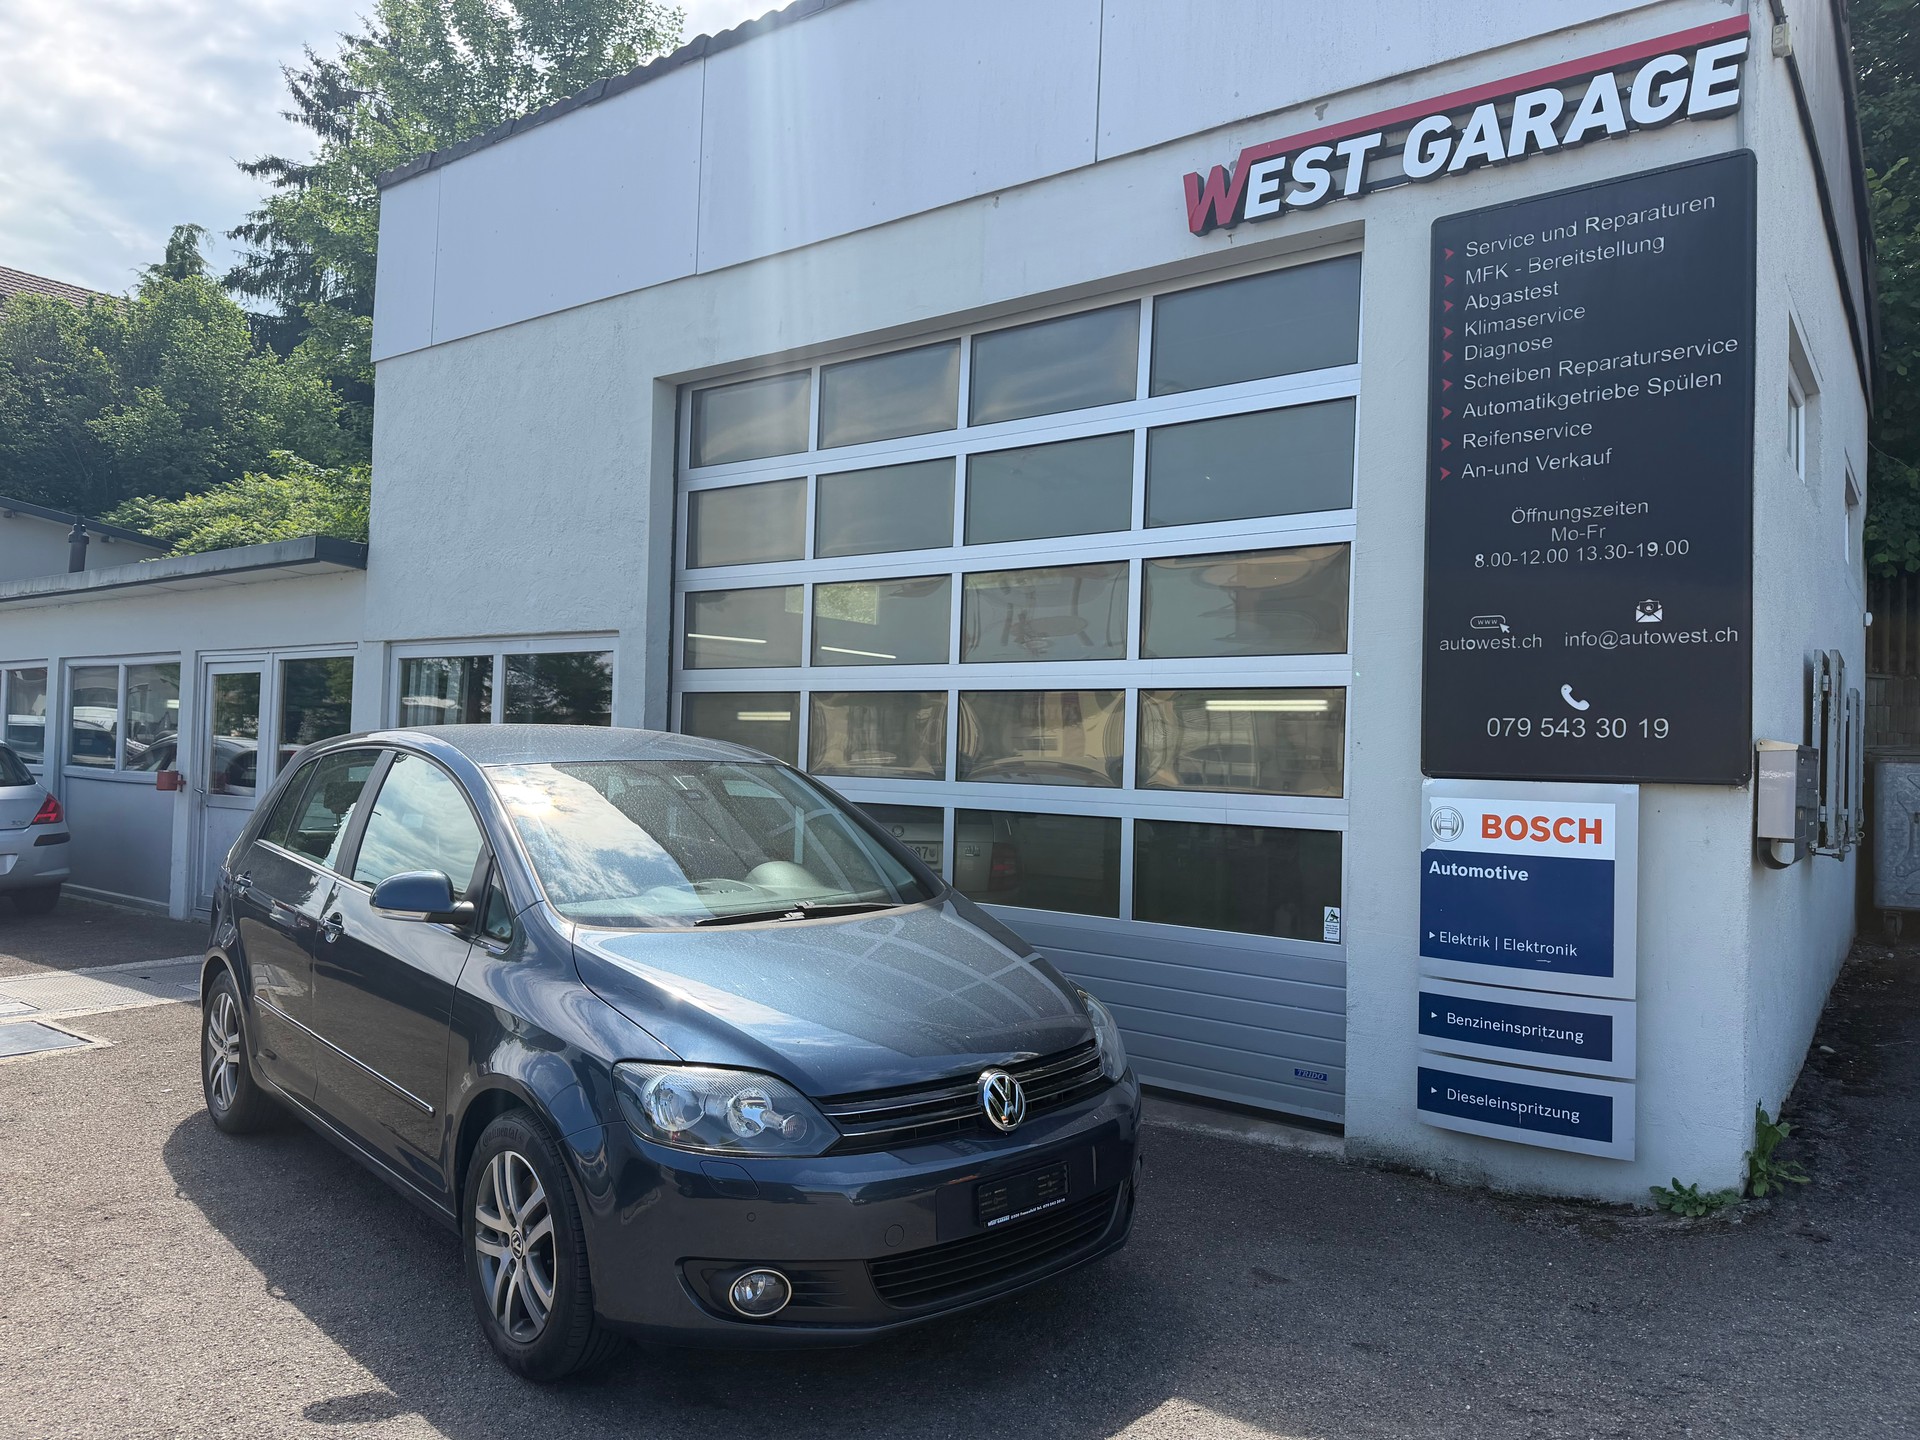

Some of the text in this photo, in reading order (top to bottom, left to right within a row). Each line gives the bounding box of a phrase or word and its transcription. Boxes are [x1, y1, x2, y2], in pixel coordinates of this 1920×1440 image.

[1183, 37, 1749, 236] WEST GARAGE
[1465, 195, 1716, 258] Service und Reparaturen
[1465, 263, 1509, 285] MFK
[1528, 235, 1666, 274] Bereitstellung
[1464, 281, 1560, 311] Abgastest
[1464, 304, 1586, 337] Klimaservice
[1464, 335, 1554, 361] Diagnose
[1464, 338, 1739, 390] Scheiben Reparaturservice
[1462, 371, 1722, 419] Automatikgetriebe Spülen
[1463, 421, 1593, 449] Reifenservice
[1461, 448, 1613, 479] An-und Verkauf
[1511, 501, 1649, 525] Öffnungszeiten
[1551, 524, 1606, 542] Mo-Fr
[1474, 539, 1690, 568] 8.00-12.00 13.30-19.00
[1439, 633, 1543, 651] autowest.ch
[1564, 627, 1739, 650] info@autowest.ch
[1486, 717, 1670, 739] 079 543 30 19
[1481, 813, 1602, 844] BOSCH
[1429, 860, 1529, 882] Automotive
[1439, 931, 1490, 948] Elektrik
[1503, 938, 1578, 957] Elektronik
[1446, 1012, 1584, 1045] Benzineinspritzung
[1297, 1069, 1324, 1080] TRIDO
[1446, 1088, 1581, 1124] Dieseleinspritzung
